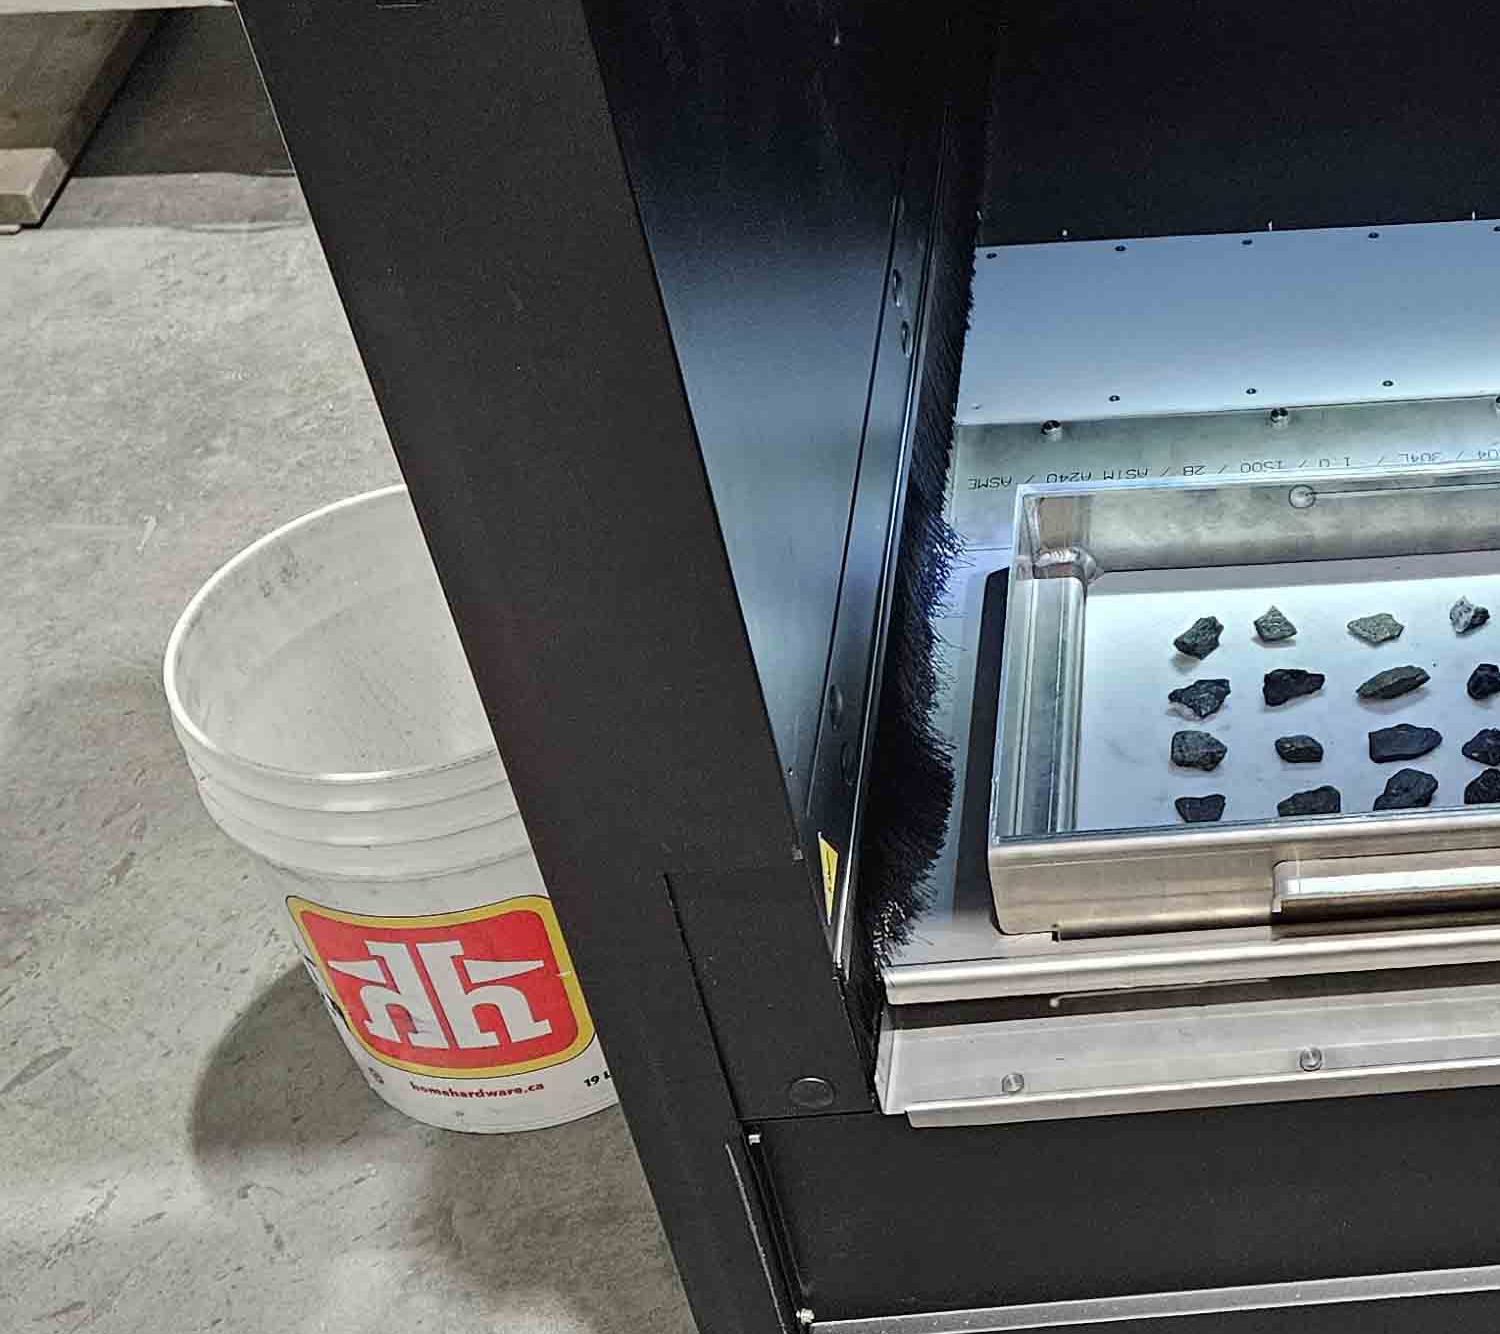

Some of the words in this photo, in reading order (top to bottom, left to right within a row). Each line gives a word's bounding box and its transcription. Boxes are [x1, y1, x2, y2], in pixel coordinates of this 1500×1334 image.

[968, 476, 1012, 490] ASME
[584, 1075, 600, 1087] 19
[409, 1081, 544, 1098] homehardware.ca
